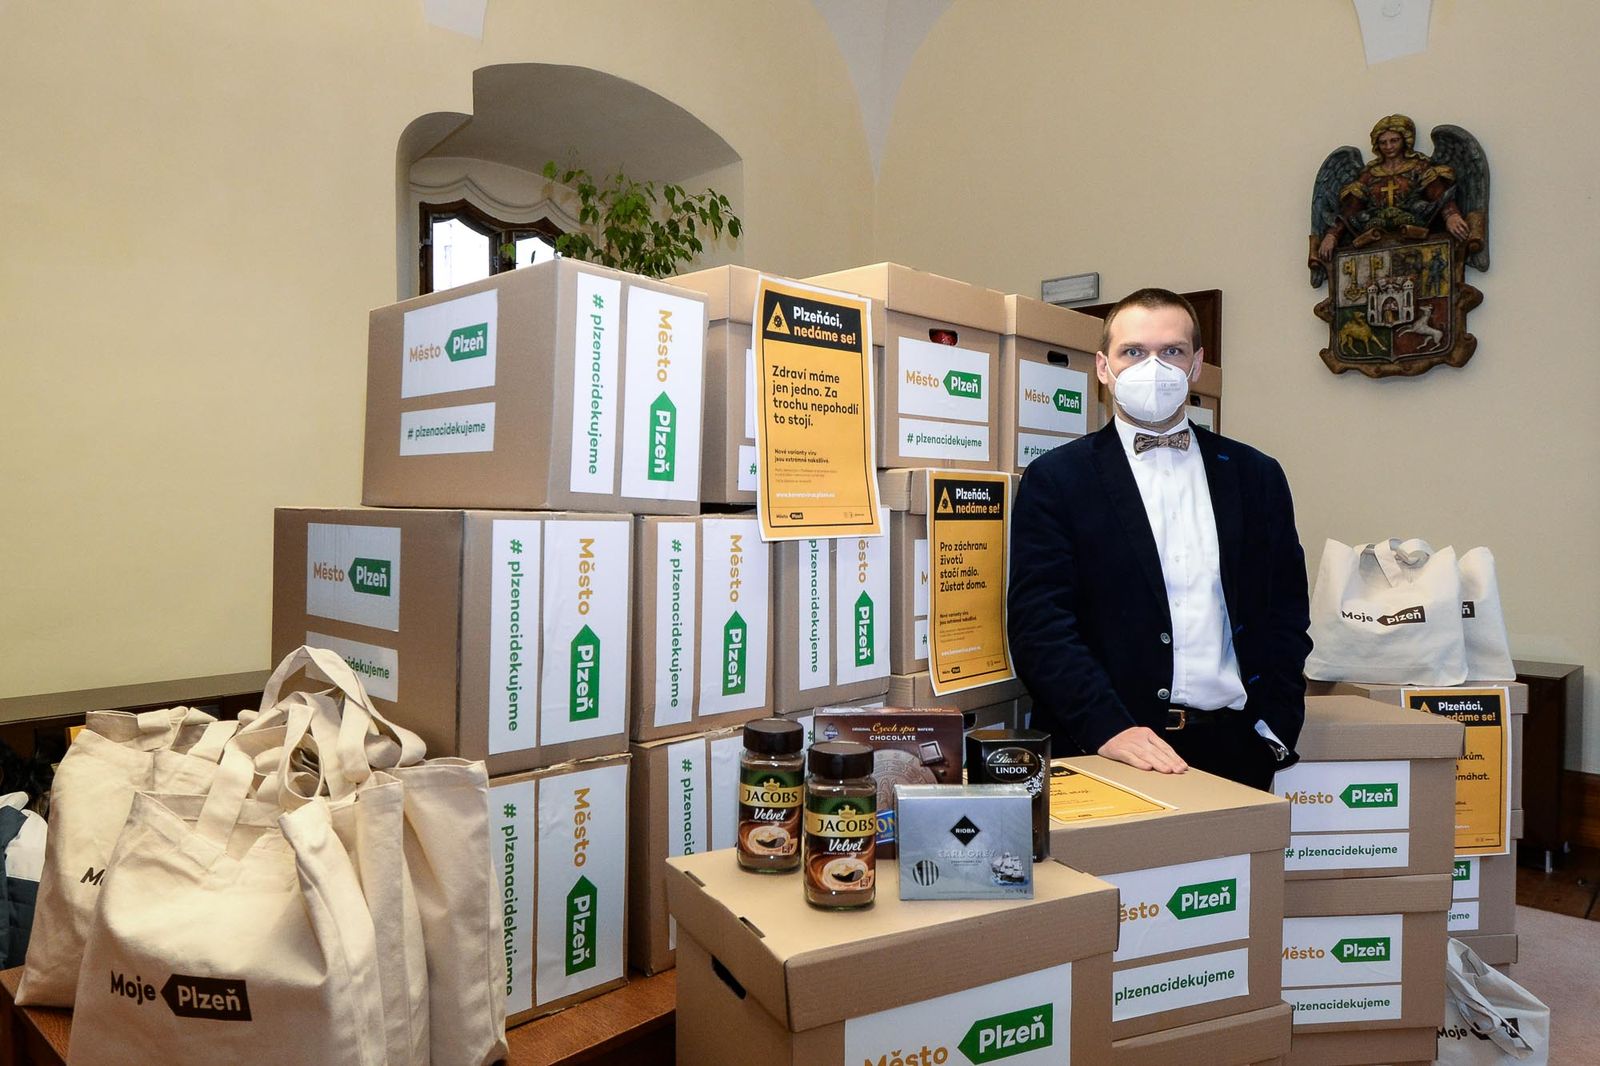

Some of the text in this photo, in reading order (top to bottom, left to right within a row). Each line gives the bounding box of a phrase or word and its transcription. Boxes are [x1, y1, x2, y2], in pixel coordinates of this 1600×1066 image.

[793, 306, 843, 329] Plzeňáci,
[793, 325, 856, 344] nedáme se!
[409, 330, 484, 363] Město Plzeň
[772, 365, 840, 383] Zdraví máme
[906, 369, 978, 394] Město Plzeň
[588, 314, 604, 475] plzenacidekujeme
[653, 310, 673, 474] Město Plzeň
[772, 380, 838, 398] jen jedno. Za
[773, 397, 859, 416] trochu nepohodlí
[1025, 388, 1080, 409] Město Plzeň
[774, 413, 814, 429] to stojí.
[415, 421, 486, 441] plzenacidekujeme
[916, 432, 982, 448] plzenacidekujeme
[955, 488, 991, 501] Plzeňáci,
[955, 502, 1000, 514] nedáme se!
[940, 541, 987, 552] Pro záchranu
[940, 553, 964, 565] životů
[313, 561, 387, 588] Město Plzeň
[940, 567, 980, 579] stačí málo.
[940, 579, 988, 593] Zůstat doma.
[727, 534, 743, 689] Město Plzeň
[1341, 610, 1422, 625] Moje Plzeň
[576, 538, 595, 713] Město Plzeň
[670, 558, 682, 708] plzenacidekujeme
[859, 606, 871, 660] Plzeň
[508, 561, 524, 731] plzenacidekujeme
[1438, 701, 1483, 711] Plzeňáci,
[1481, 713, 1496, 721] se!
[872, 722, 897, 734] Czech
[900, 726, 915, 734] spa
[996, 766, 1028, 774] LINDOR
[745, 790, 798, 804] JACOBS
[1285, 788, 1393, 805] Město Plzeň
[754, 808, 786, 821] Velvet
[817, 819, 874, 833] JACOBS
[829, 839, 864, 852] Velvet
[1299, 845, 1398, 857] plzenacidekujeme
[573, 788, 592, 965] Město Plzeň
[1181, 887, 1231, 912] Plzeň
[1343, 942, 1385, 958] Plzeň
[111, 970, 241, 1012] Moje Plzeň
[1115, 969, 1235, 1005] plzenacidekujeme
[978, 1014, 1045, 1054] Plzeň
[1437, 1025, 1468, 1040] Moje
